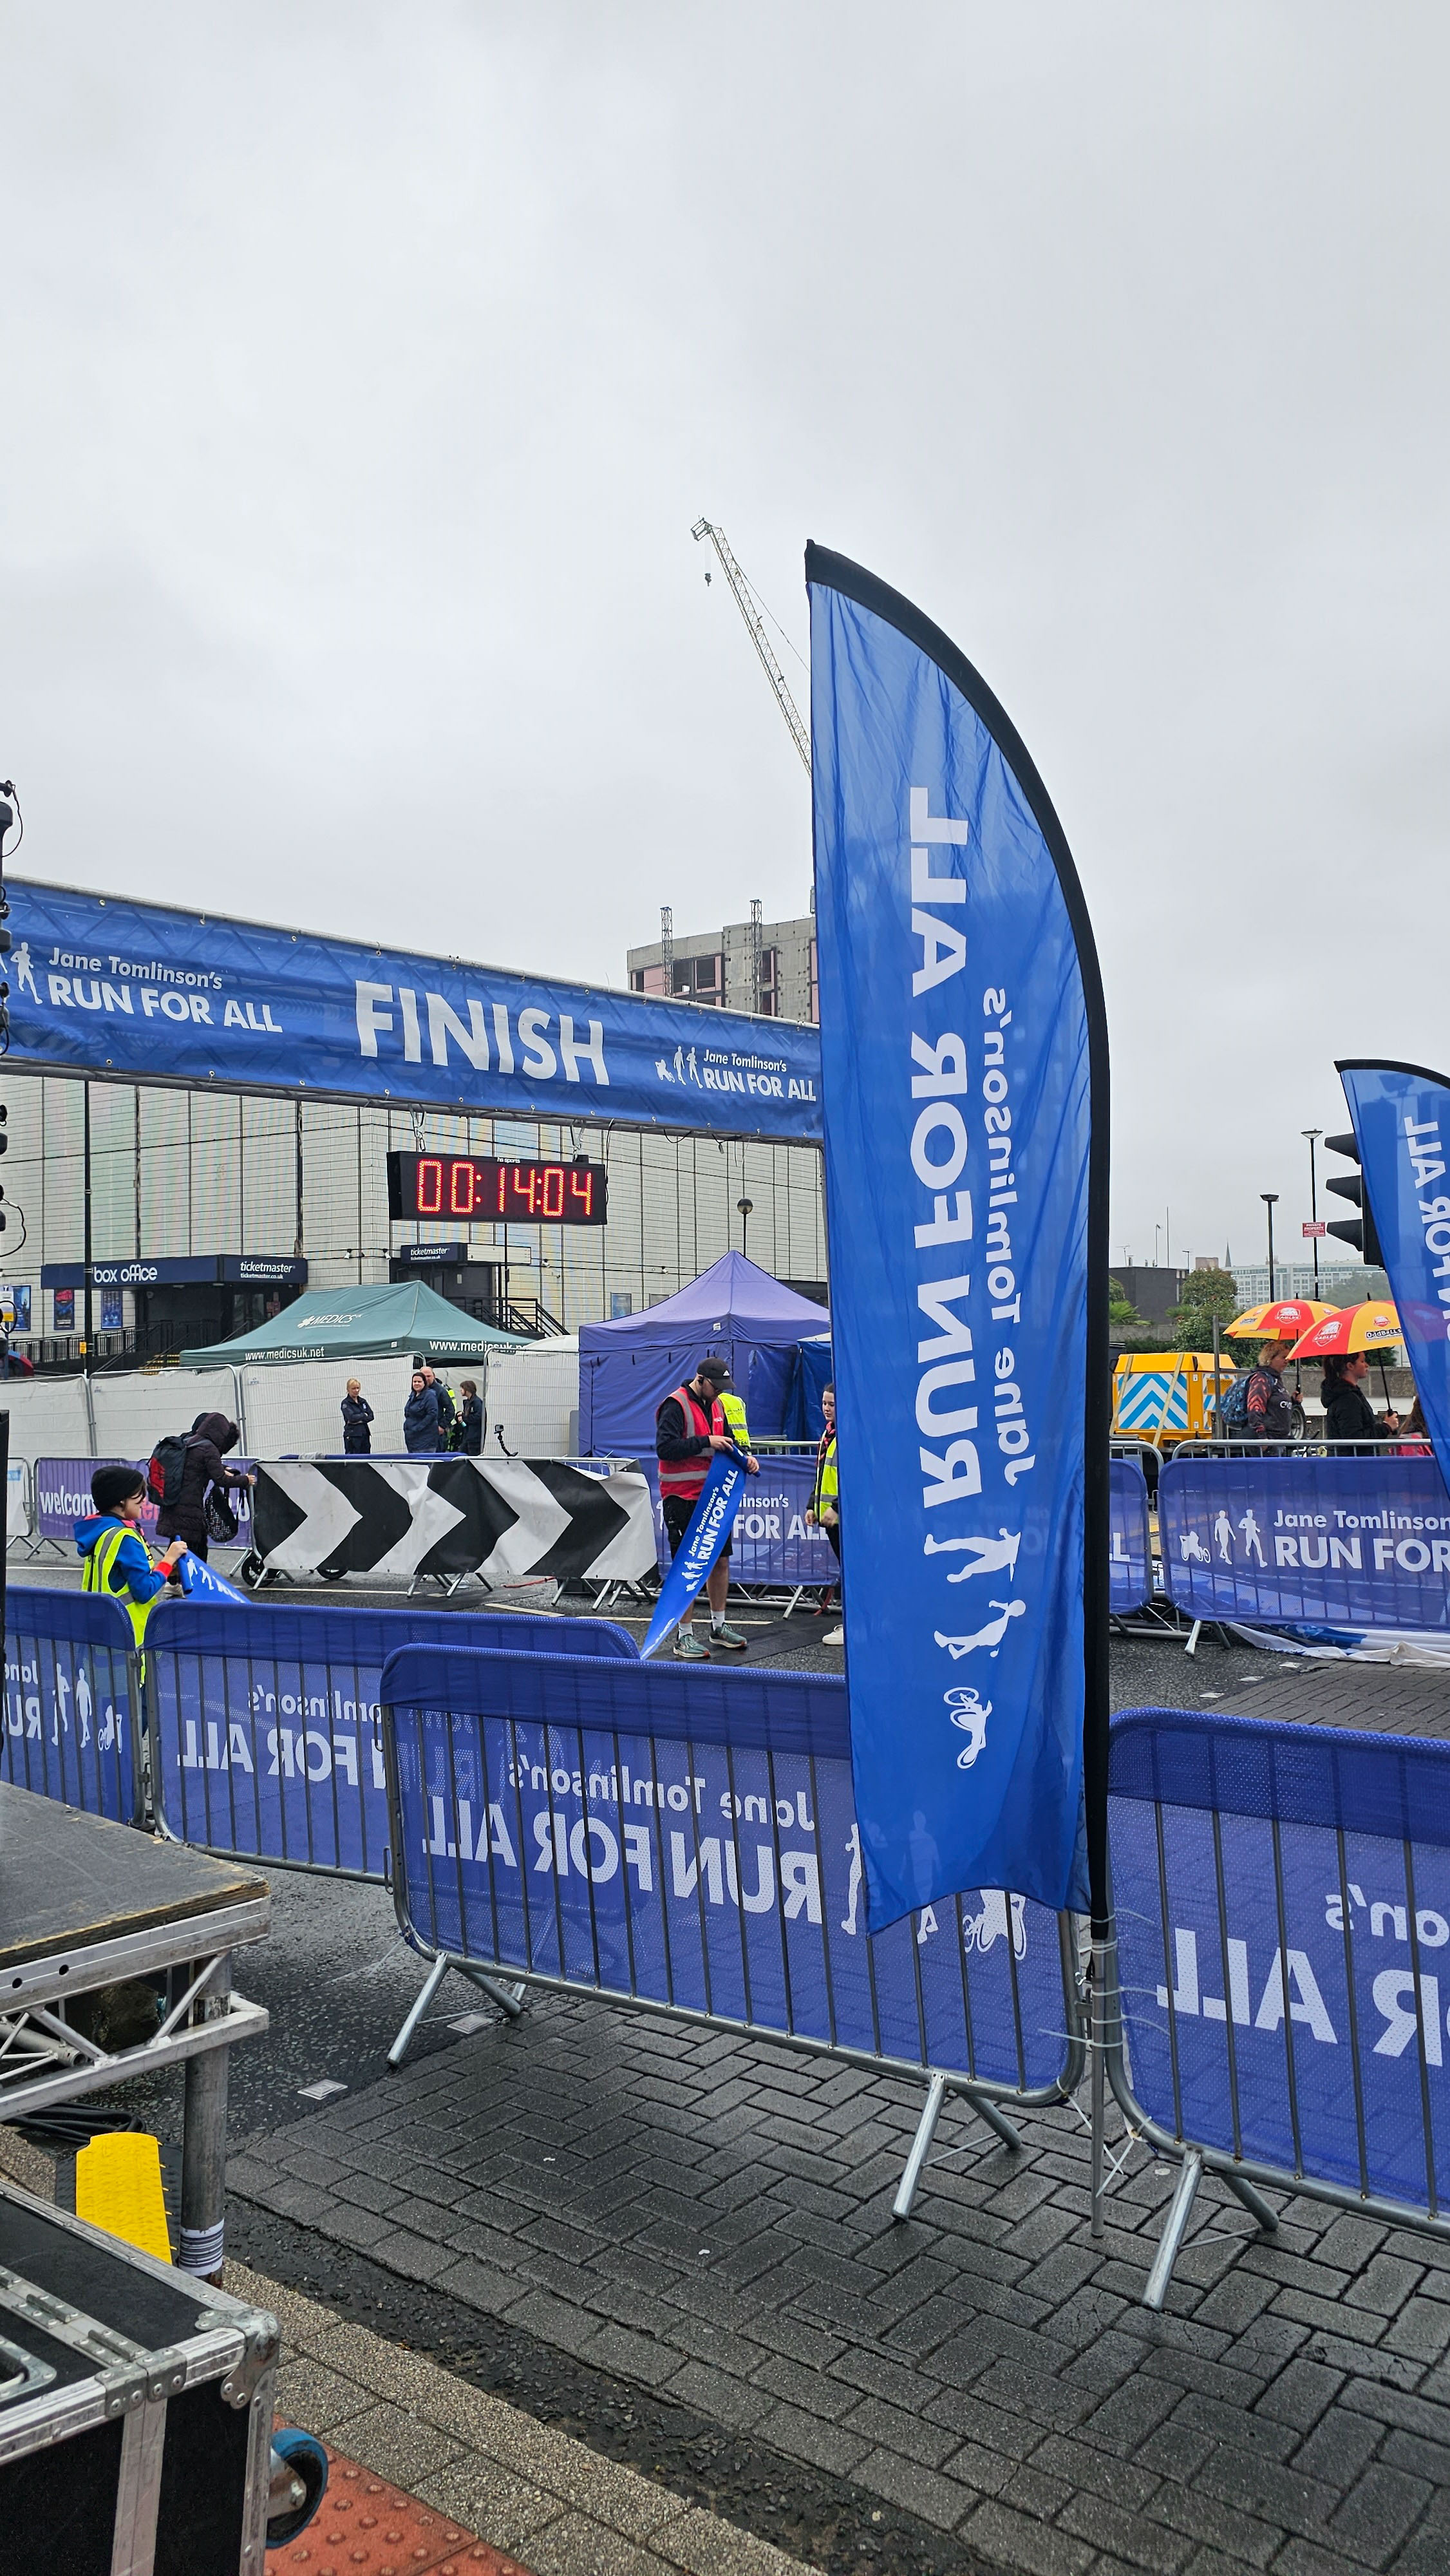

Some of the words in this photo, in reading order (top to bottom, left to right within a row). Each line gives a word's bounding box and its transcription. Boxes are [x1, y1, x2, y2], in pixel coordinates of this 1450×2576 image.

[48, 947, 102, 972] Jane
[108, 956, 223, 990] Tomlinson's
[48, 974, 135, 1014] RUN
[140, 987, 214, 1025] FOR
[223, 999, 283, 1033] ALL
[355, 980, 610, 1086] FINISH
[703, 1049, 729, 1065] Jane
[731, 1053, 787, 1072] Tomlinson's
[702, 1068, 746, 1093] RUN
[746, 1073, 784, 1097] FOR
[787, 1078, 816, 1102] ALL
[417, 1160, 592, 1216] 00:14:04
[410, 1247, 448, 1256] ticketmaster
[94, 1266, 118, 1283] box
[120, 1264, 158, 1282] office
[240, 1260, 293, 1273] ticketmaster
[310, 1314, 356, 1325] MEDICS
[245, 1346, 325, 1361] www.medicsuk.net
[39, 1485, 99, 1517] welcom
[697, 1528, 719, 1560] RUN
[708, 1497, 728, 1528] FOR
[722, 1470, 739, 1497] ALL
[733, 1514, 781, 1539] FOR
[1274, 1510, 1327, 1528] Jane
[688, 1535, 701, 1557] Jane
[1274, 1535, 1362, 1569] RUN
